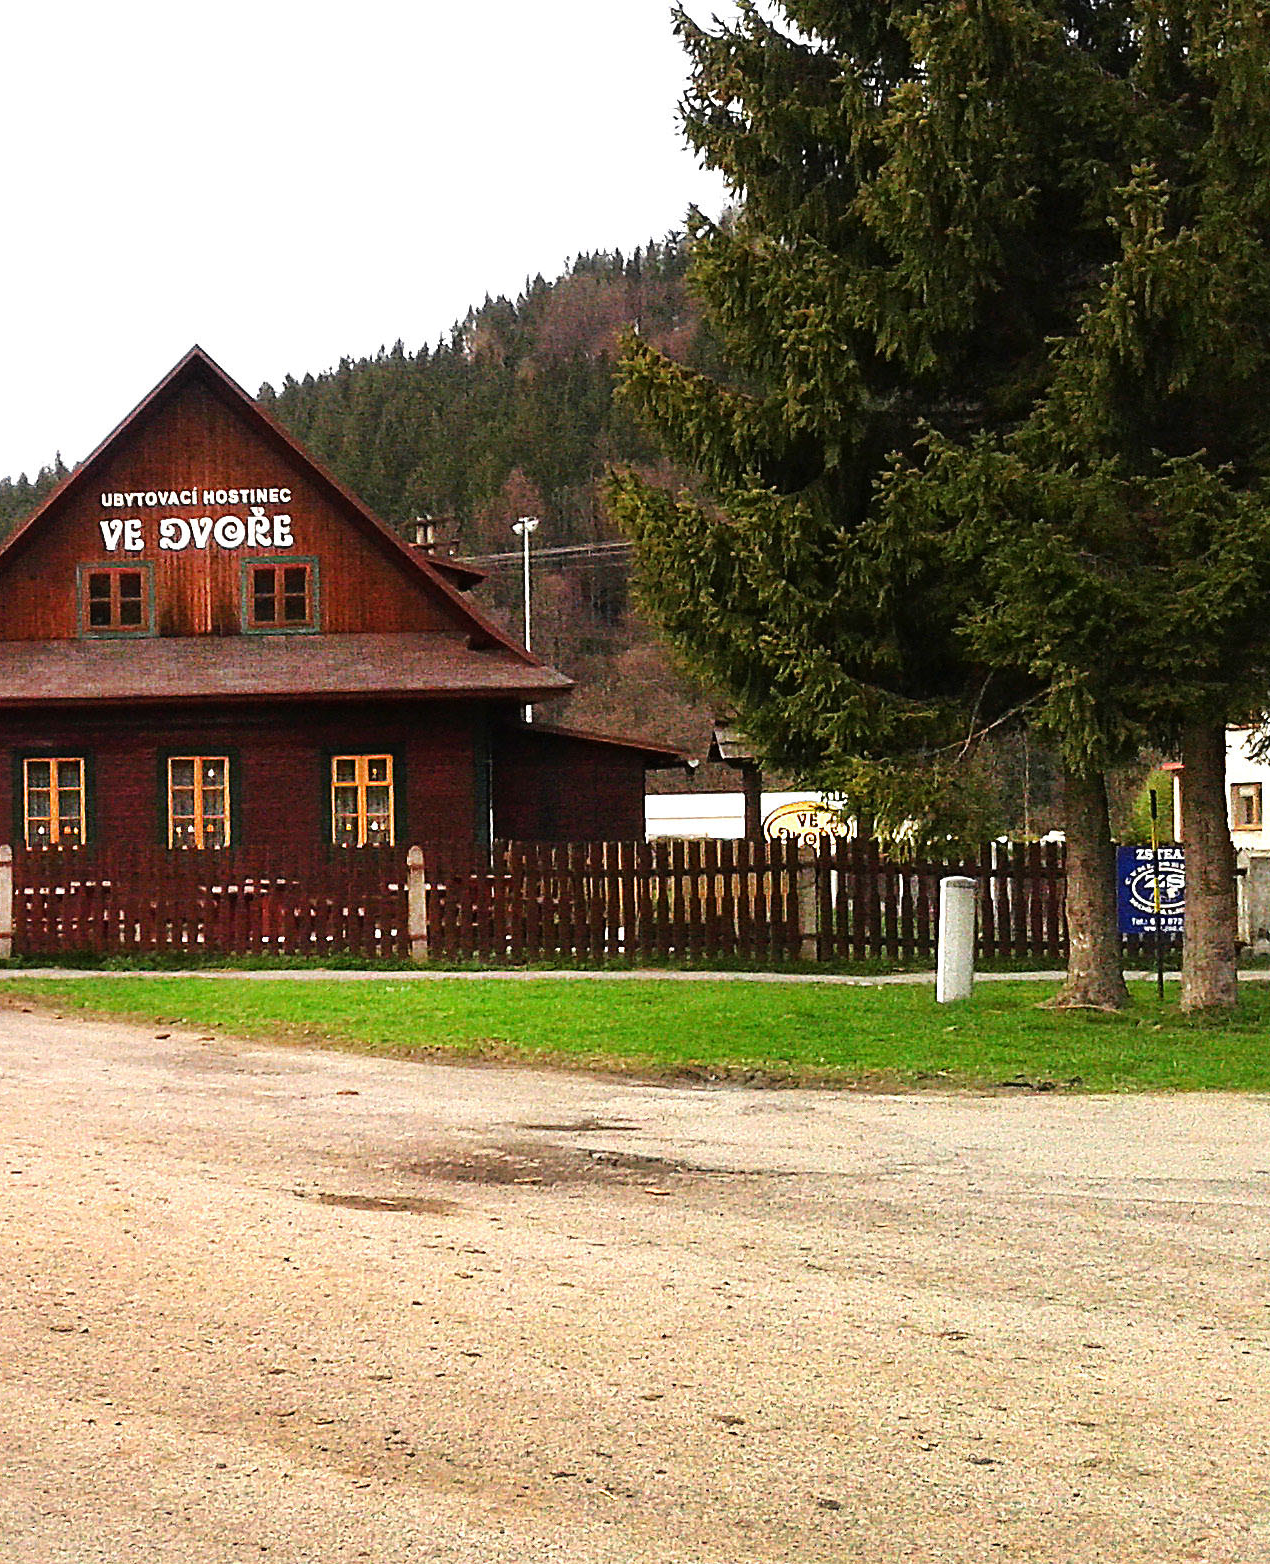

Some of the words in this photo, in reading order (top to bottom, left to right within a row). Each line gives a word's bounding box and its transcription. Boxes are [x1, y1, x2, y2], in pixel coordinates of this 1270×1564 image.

[101, 487, 198, 507] UBYTOVACÍ
[203, 488, 292, 505] HOSTINEC
[99, 519, 145, 551] VE
[159, 506, 294, 551] DVOŘE
[796, 813, 819, 828] VE
